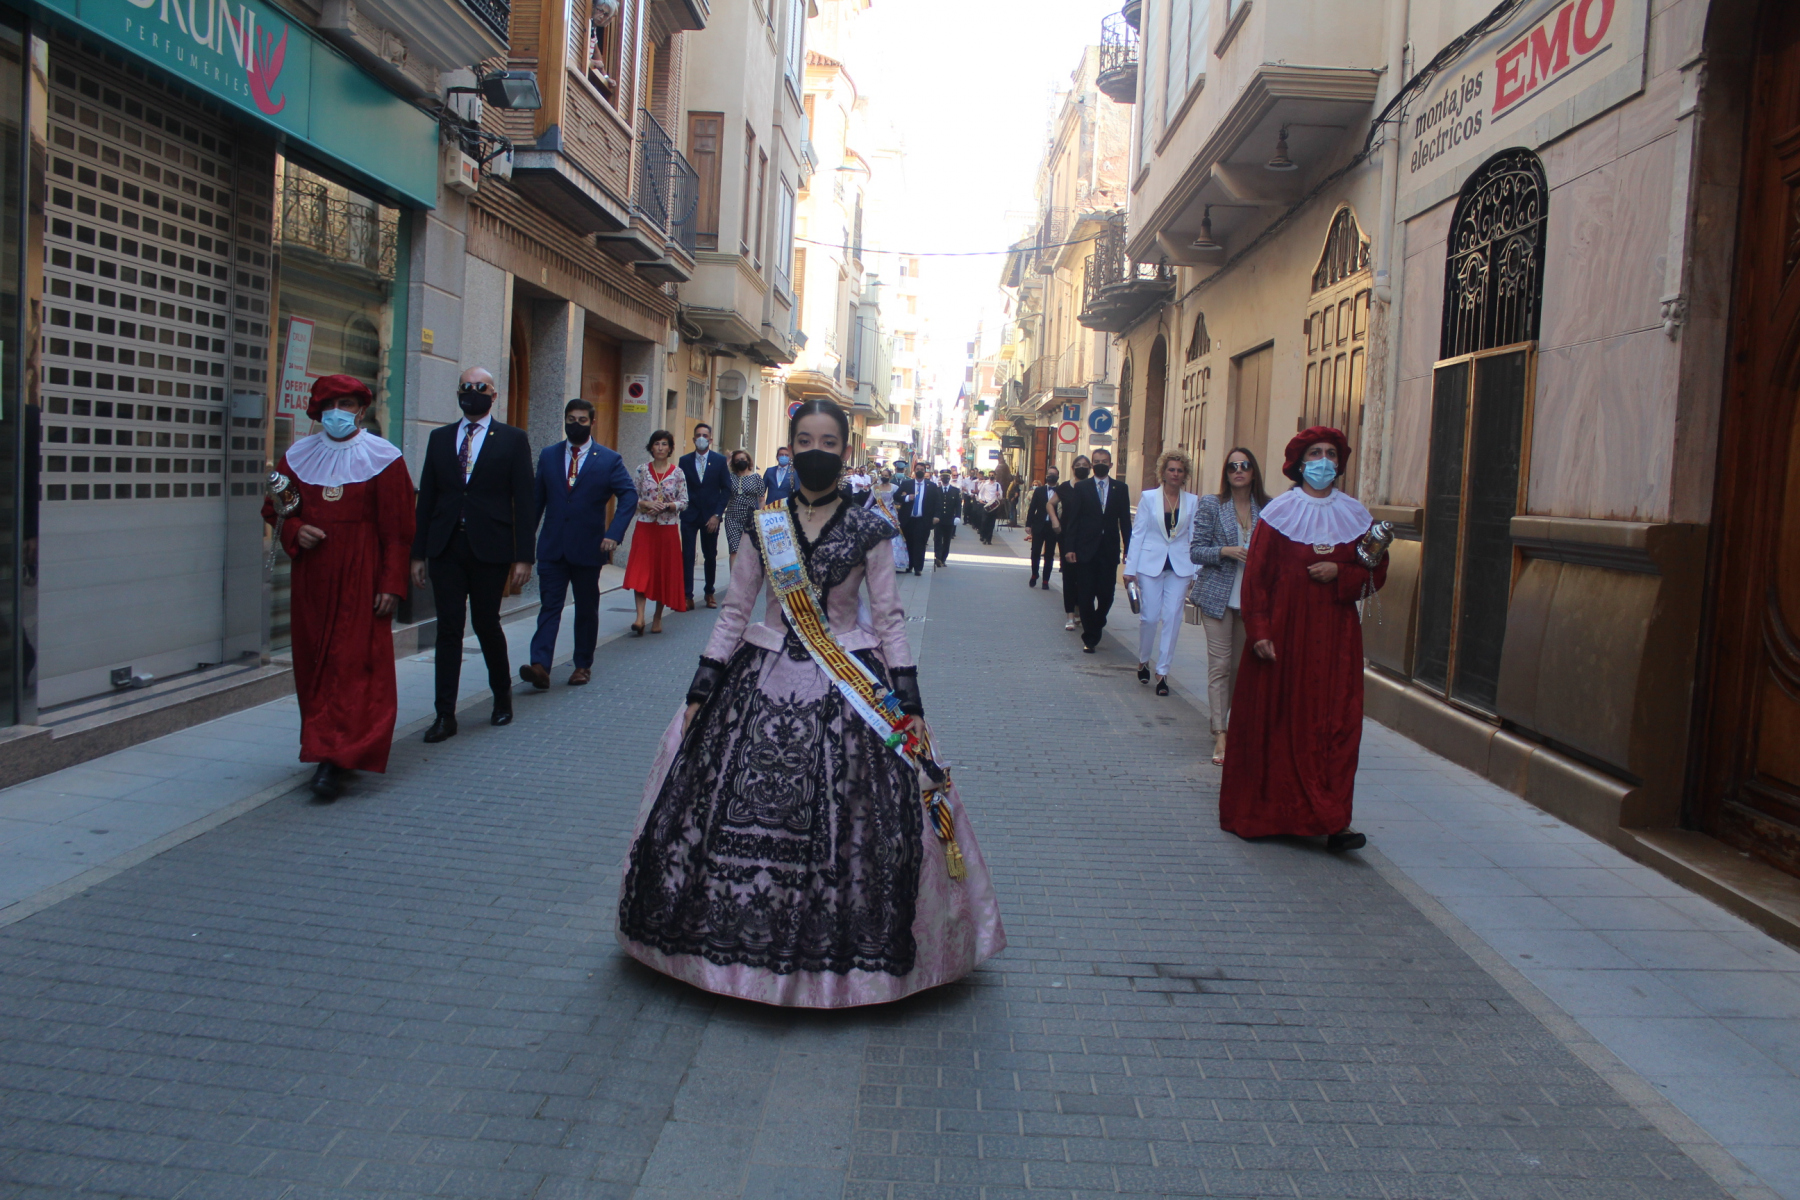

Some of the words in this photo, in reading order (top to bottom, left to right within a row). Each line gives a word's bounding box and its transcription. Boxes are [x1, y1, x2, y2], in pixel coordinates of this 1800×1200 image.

[125, 17, 249, 97] PERFUMERIES
[127, 0, 256, 73] UNI
[1492, 0, 1616, 116] EMO
[1414, 70, 1484, 140] montajes
[1410, 108, 1483, 175] electricos
[284, 393, 310, 411] FLAS
